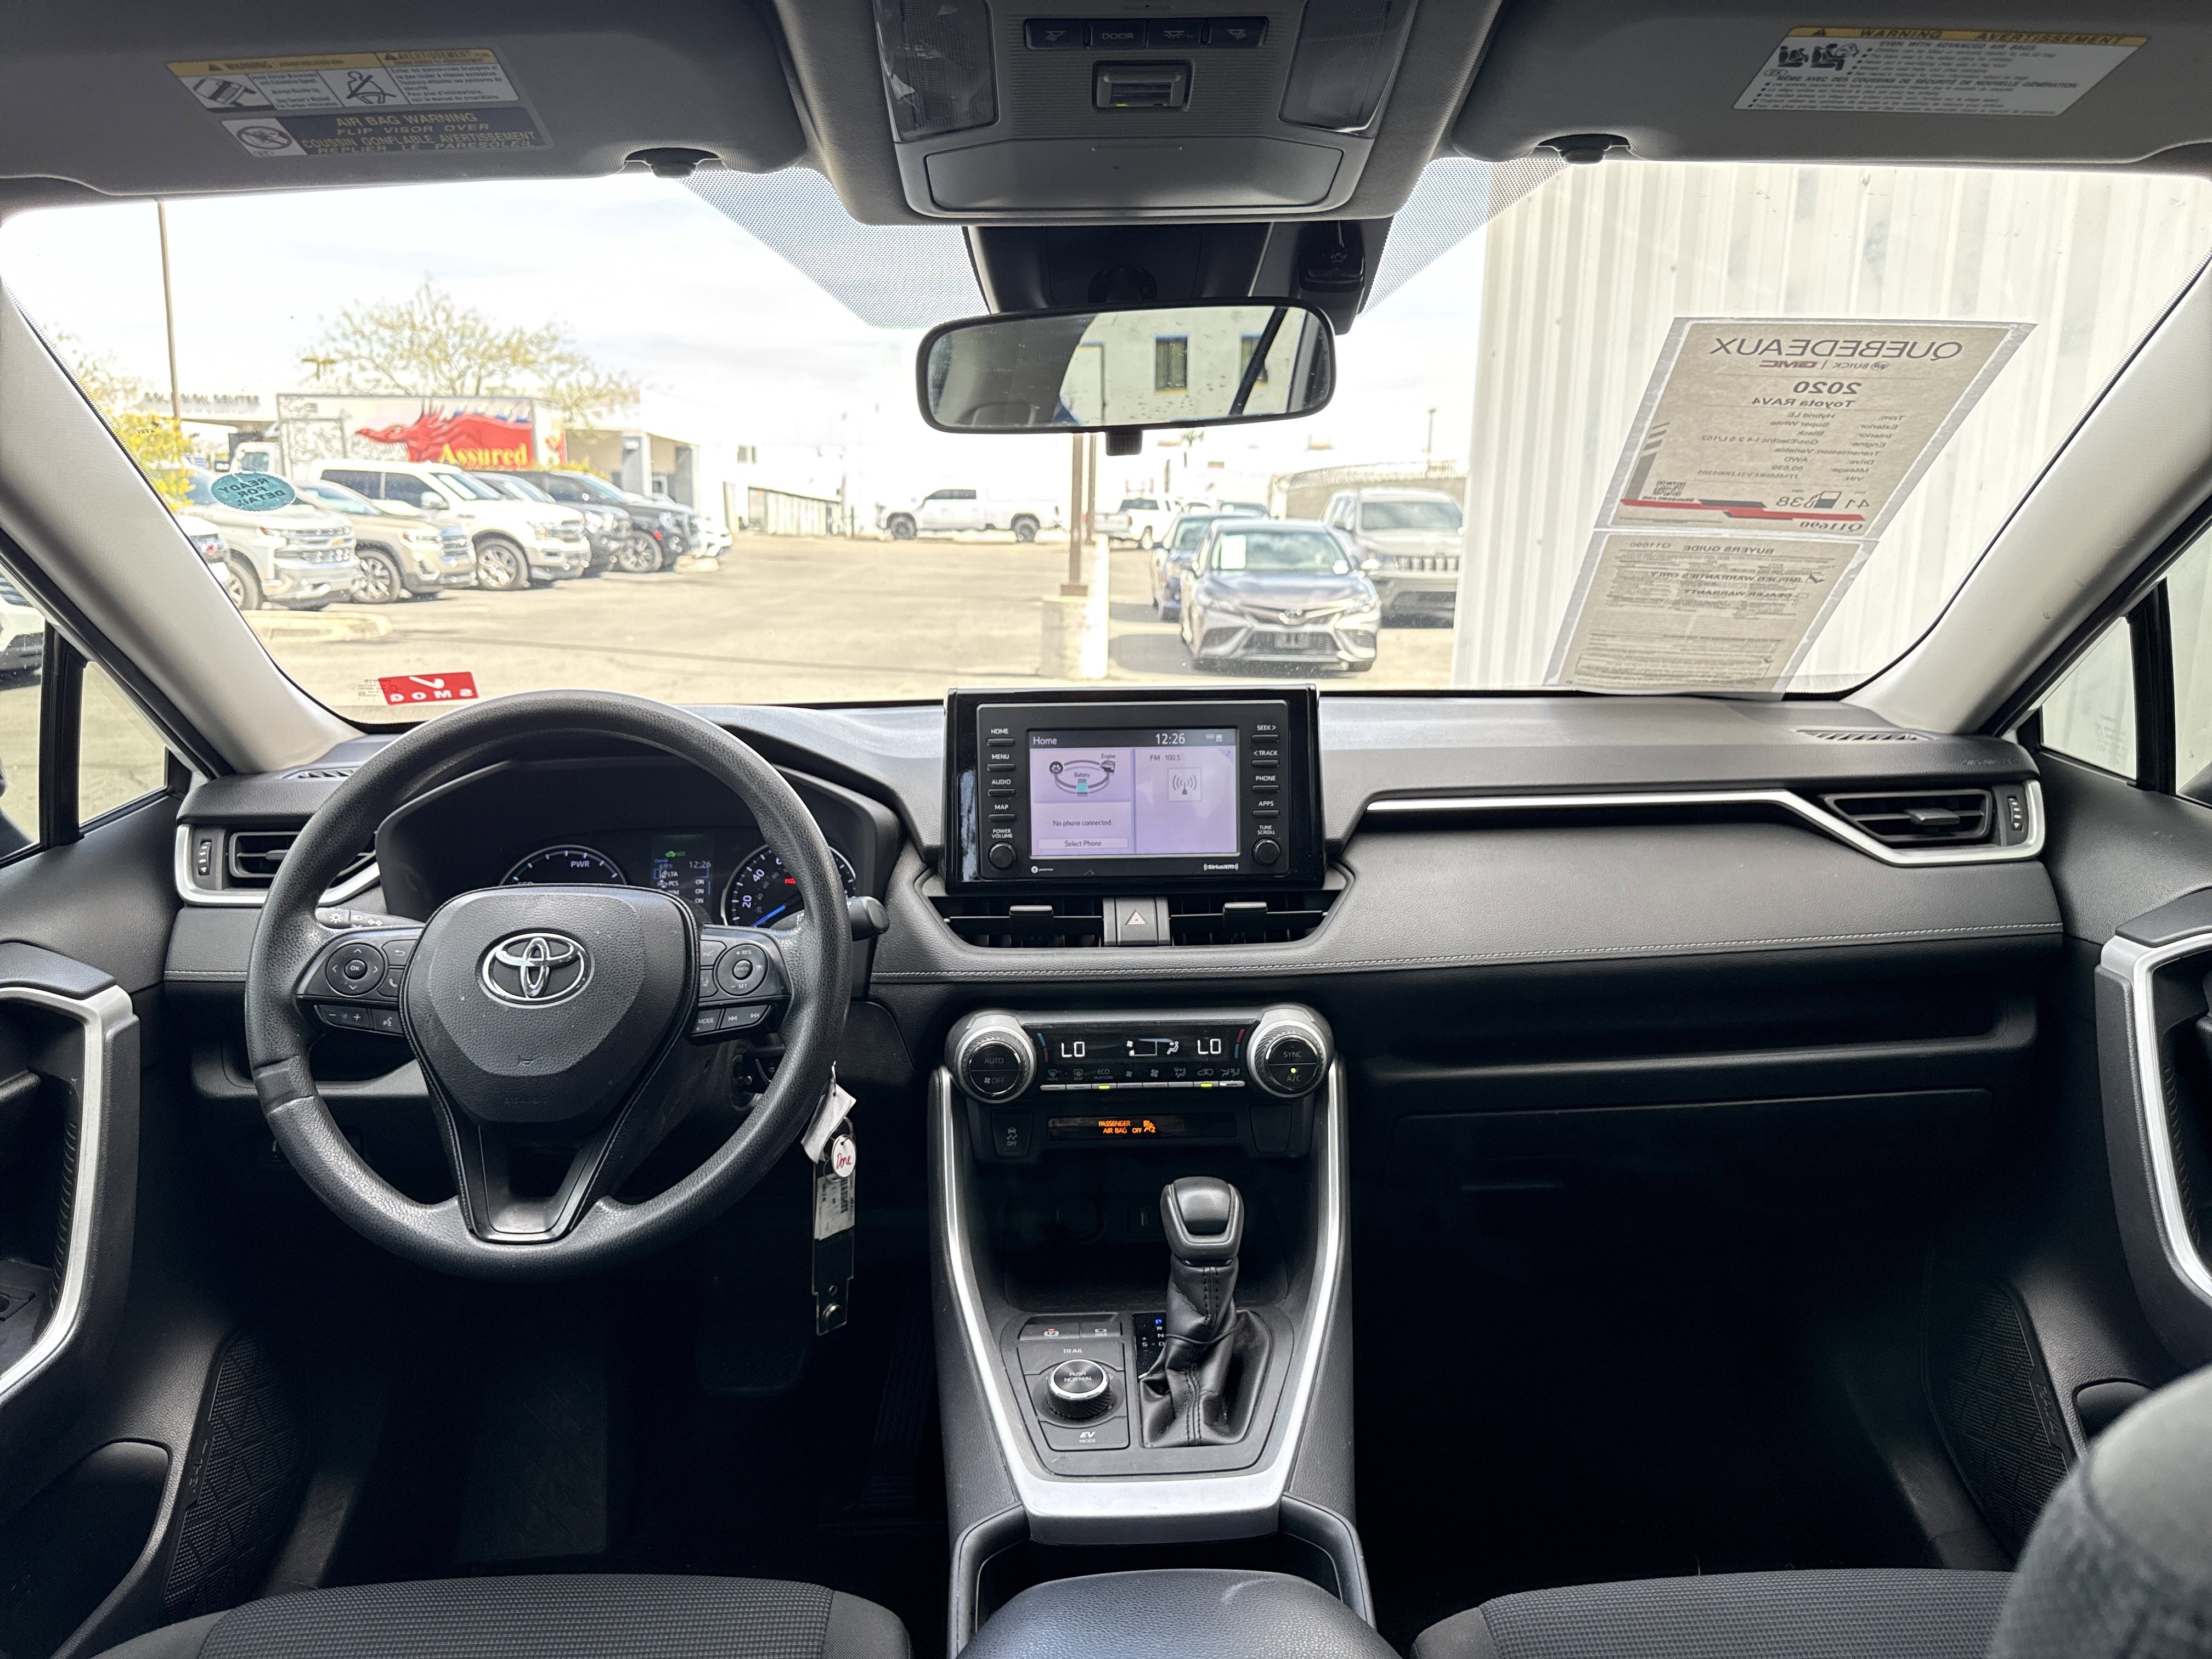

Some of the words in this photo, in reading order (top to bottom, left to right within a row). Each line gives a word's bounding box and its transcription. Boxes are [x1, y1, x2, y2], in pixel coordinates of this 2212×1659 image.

[1861, 28, 1942, 38] WARNING
[1976, 31, 2125, 44] AVERTISSEMENT
[223, 60, 272, 70] WARNING
[336, 117, 363, 127] AIR
[365, 115, 401, 126] BAG
[403, 112, 478, 125] WARNING
[383, 125, 433, 134] VISOR
[443, 123, 489, 132] OVER
[301, 137, 356, 149] COUSSIN
[361, 135, 435, 146] GONFLABLE
[439, 131, 536, 144] AVERTISSEMENT
[318, 145, 387, 155] REPLIER
[435, 140, 535, 150] PARESOLEIL
[143, 392, 210, 405] COLSION
[440, 442, 528, 467] Assured
[1033, 736, 1058, 745] Home
[1155, 732, 1186, 745] 12:26
[689, 860, 712, 869] 12:26
[752, 868, 765, 882] 40
[742, 895, 752, 909] 20
[1061, 1041, 1086, 1058] LO
[1197, 1038, 1222, 1054] LO
